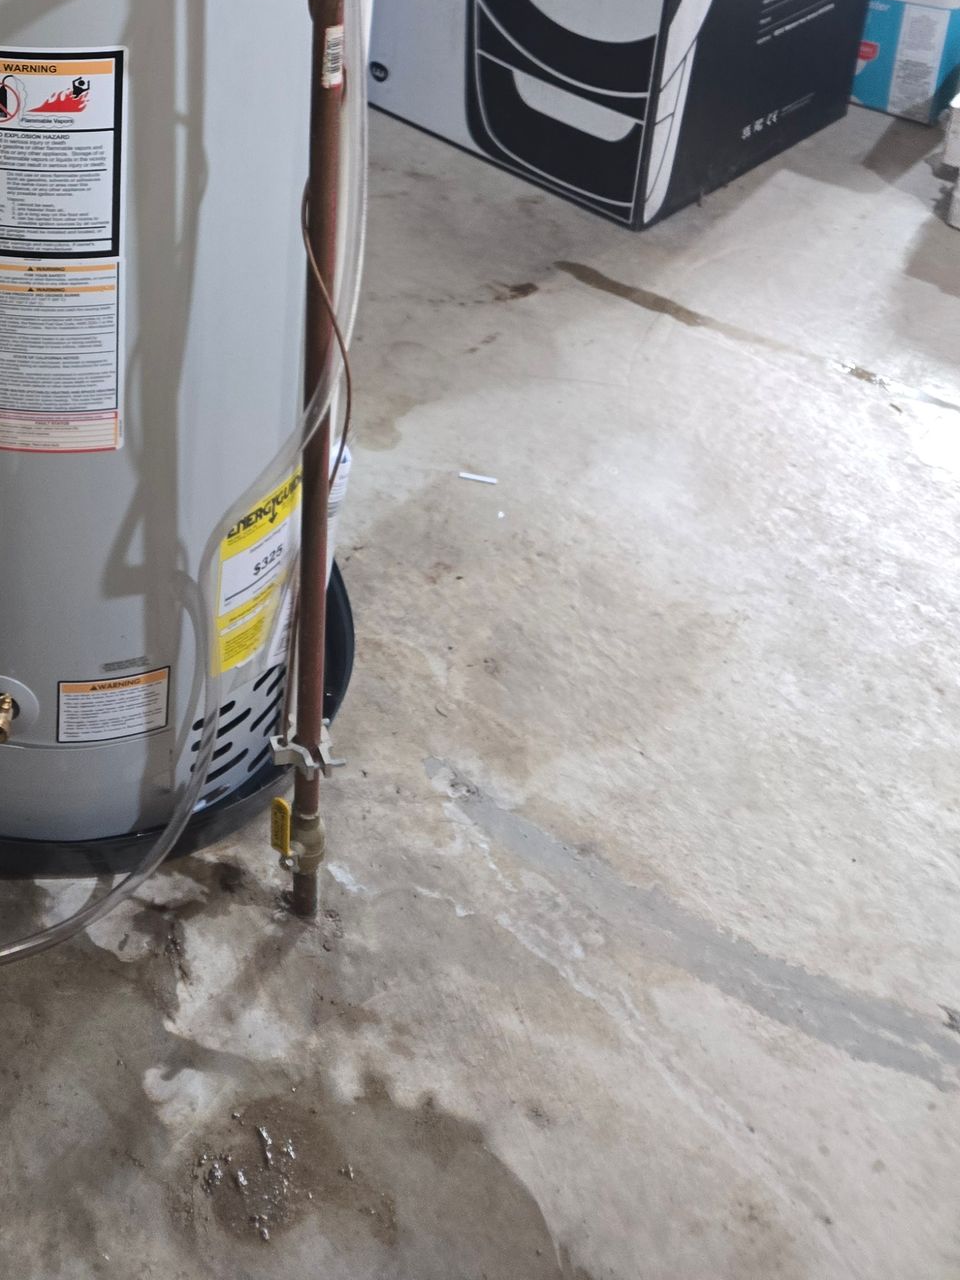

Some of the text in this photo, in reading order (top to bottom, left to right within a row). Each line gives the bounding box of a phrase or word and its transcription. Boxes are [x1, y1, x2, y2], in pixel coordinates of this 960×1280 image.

[3, 63, 57, 73] WARNING
[4, 132, 41, 140] EXPLOSION
[97, 679, 141, 690] WARNING
